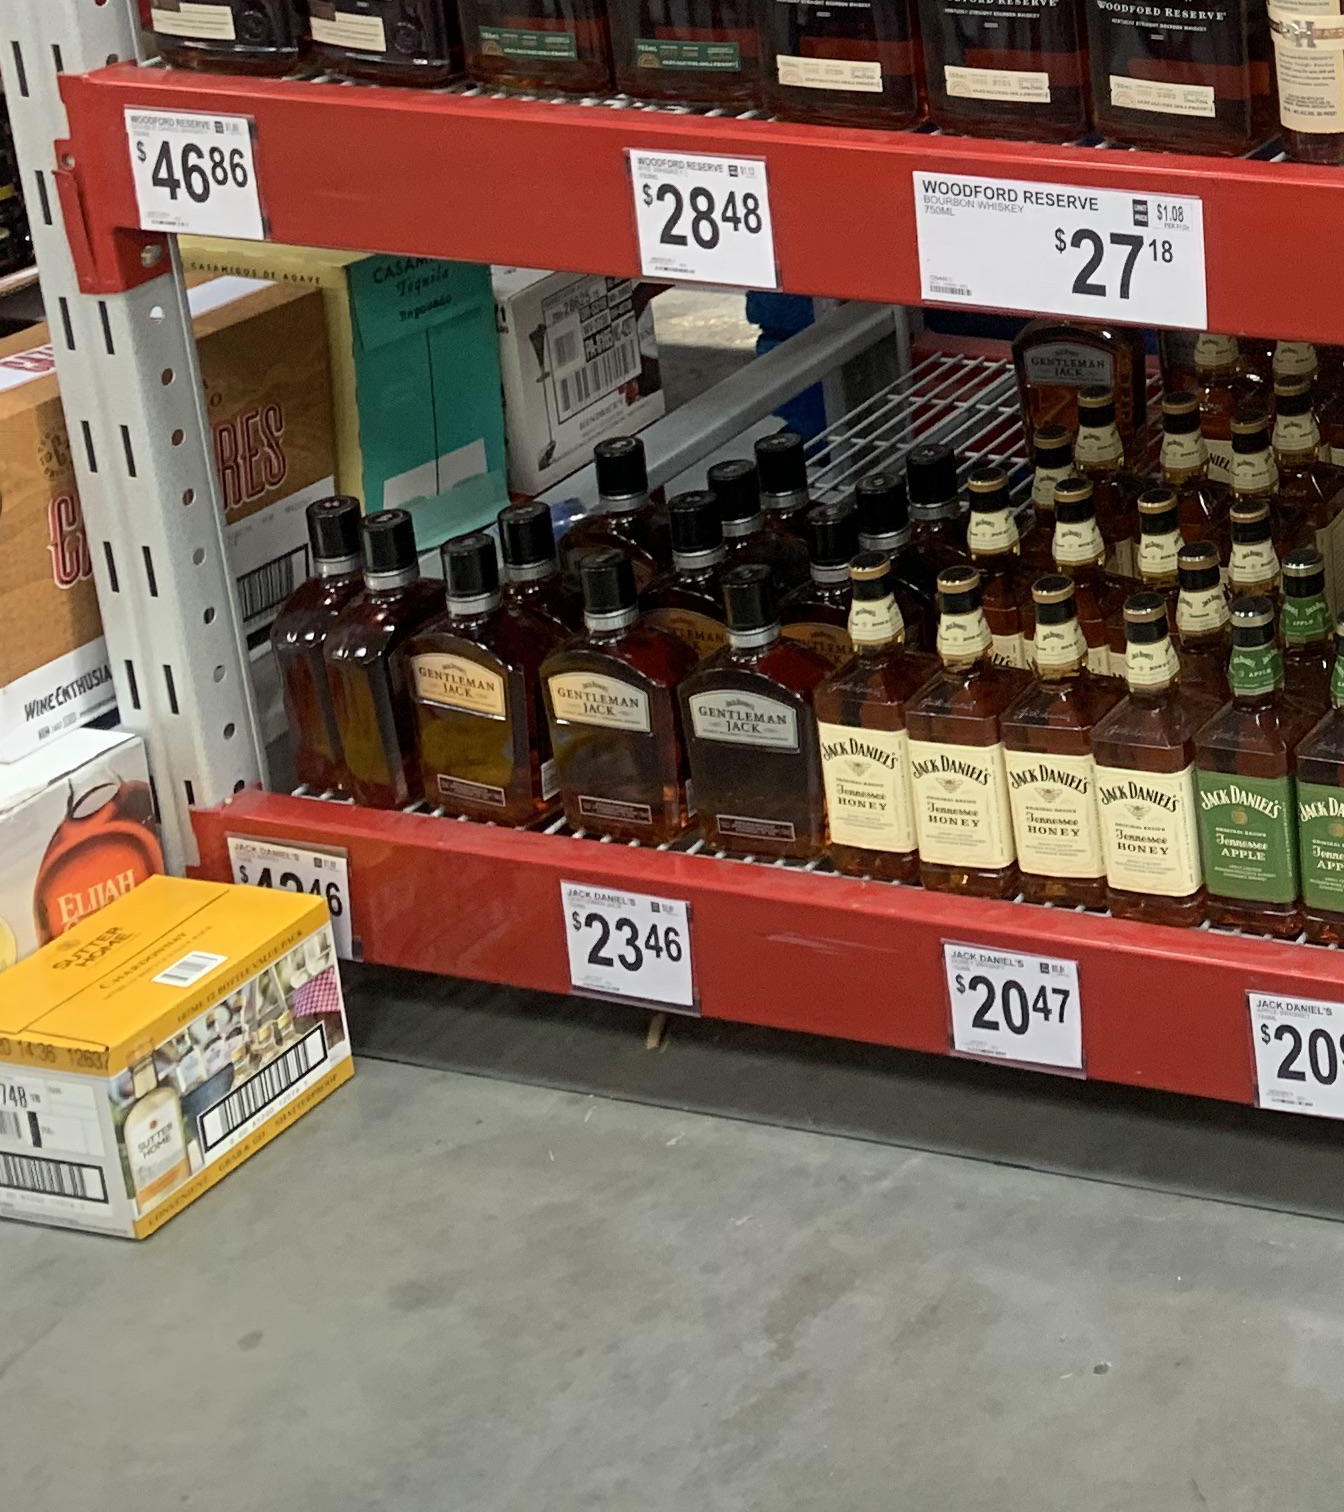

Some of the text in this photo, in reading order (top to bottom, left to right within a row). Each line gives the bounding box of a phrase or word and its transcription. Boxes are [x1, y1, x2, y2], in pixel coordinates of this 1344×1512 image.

[922, 180, 1098, 211] WOODFORD RESERVE
[924, 195, 1024, 213] BOURBON WHISKEY
[419, 667, 495, 691] GENTLEMAN
[584, 703, 614, 716] JACK
[726, 720, 760, 733] JACK
[929, 815, 980, 827] HONEY
[1028, 825, 1080, 837] HONEY
[1221, 848, 1266, 861] APPLE
[567, 889, 636, 906] JACK DANIEL'S
[952, 951, 1024, 968] JACK DANIEL'S
[1257, 1000, 1332, 1016] JACK DANIEL'S
